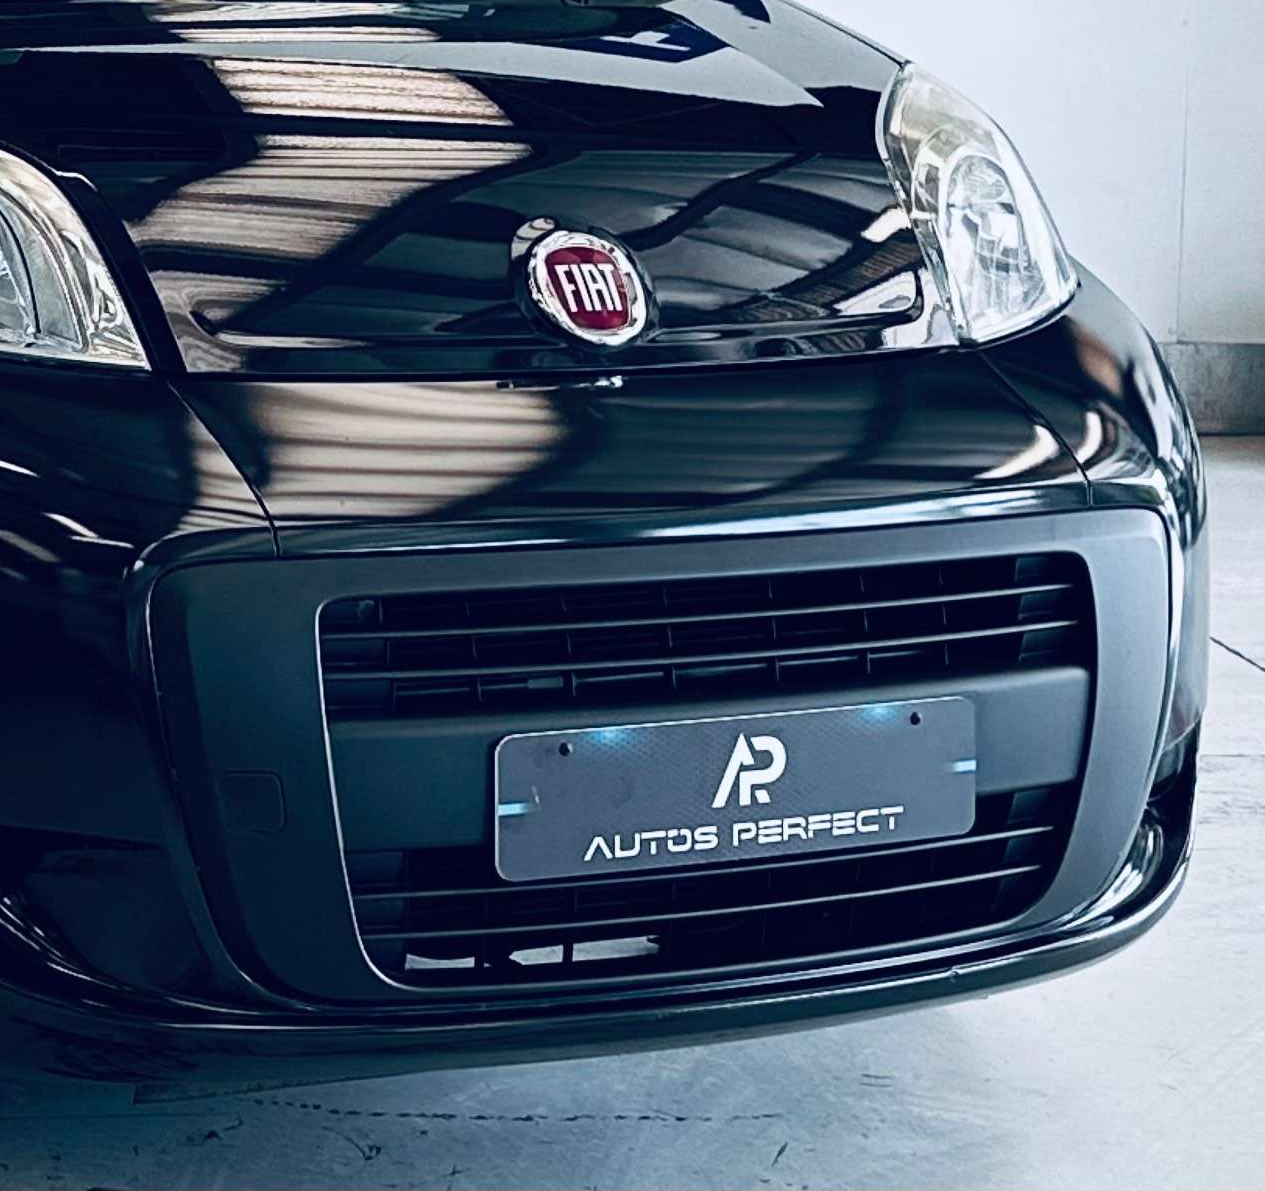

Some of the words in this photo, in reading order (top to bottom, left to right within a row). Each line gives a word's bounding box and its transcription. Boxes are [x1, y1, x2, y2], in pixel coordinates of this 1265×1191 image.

[554, 263, 623, 313] FIAT
[583, 825, 719, 861] AUTOS
[732, 805, 904, 847] PERFECT
